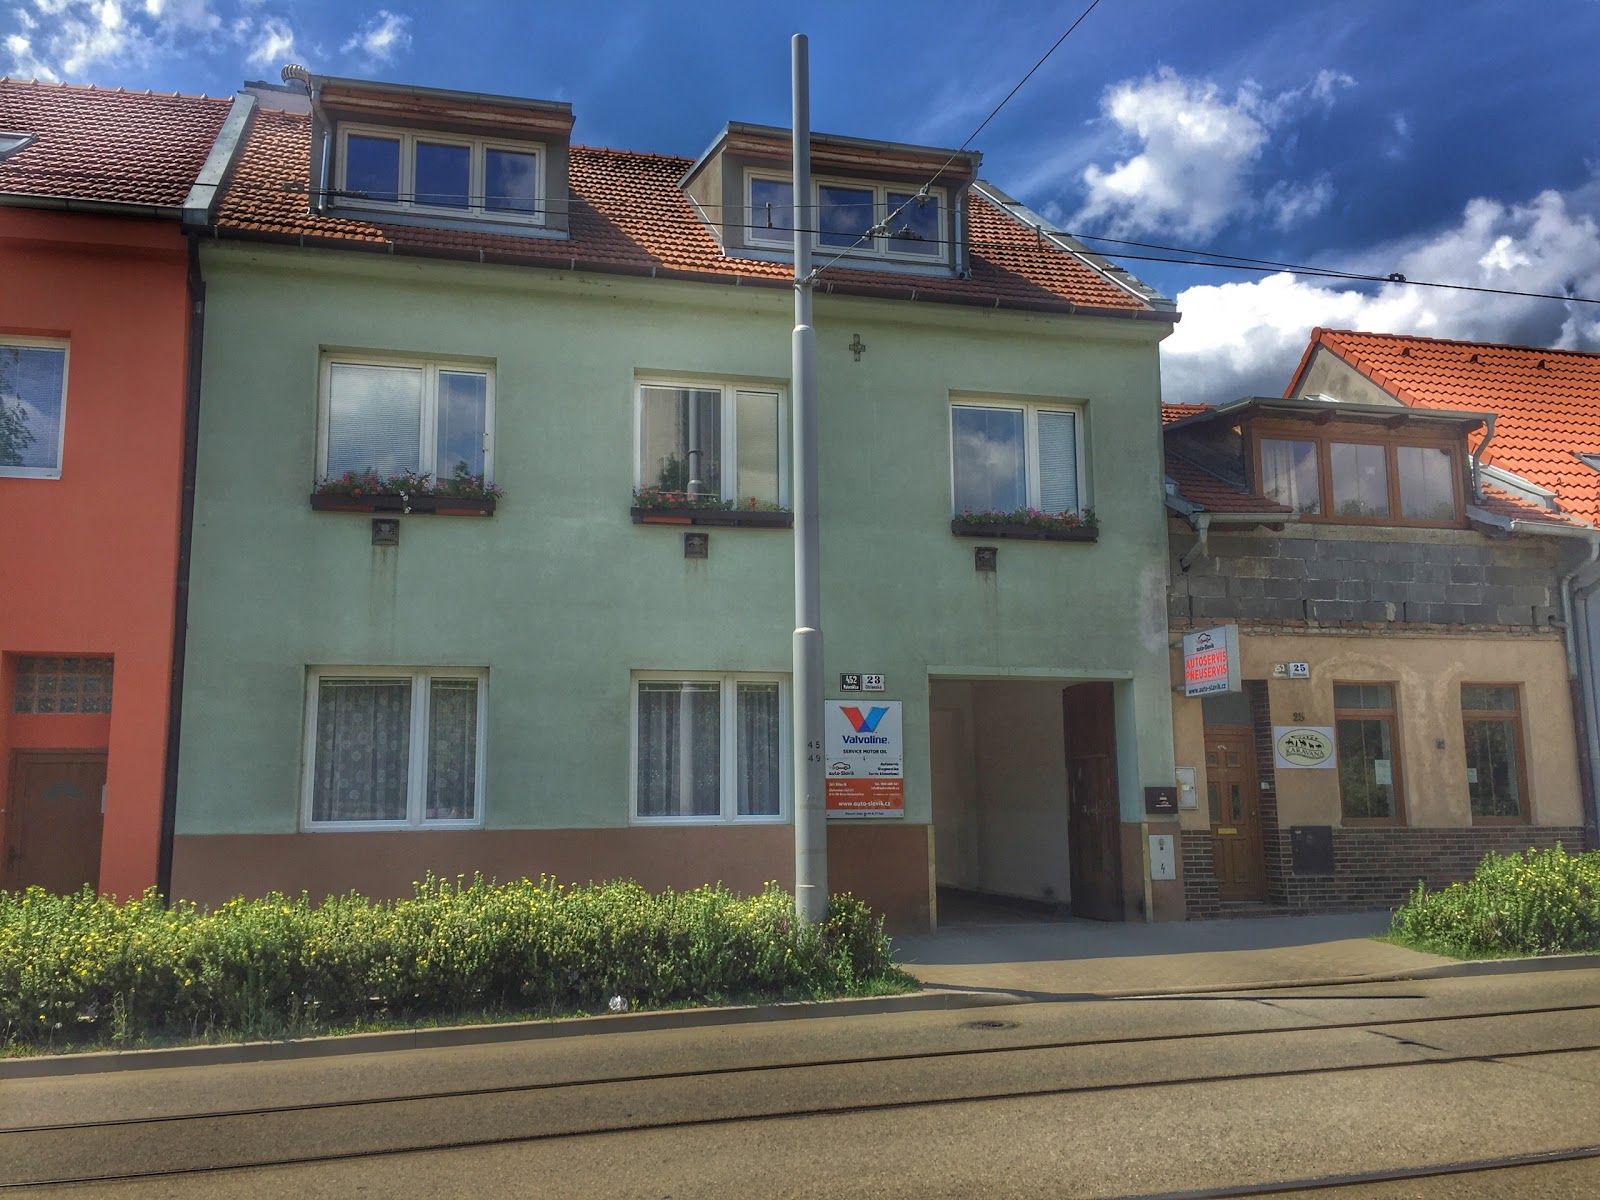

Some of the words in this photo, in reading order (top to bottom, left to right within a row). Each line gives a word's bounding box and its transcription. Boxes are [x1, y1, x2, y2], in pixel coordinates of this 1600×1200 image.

[1185, 651, 1227, 670] AUTOSERVIS
[1293, 664, 1306, 672] 25
[845, 675, 858, 685] 452
[867, 675, 881, 684] 23
[842, 735, 888, 744] Valvoline
